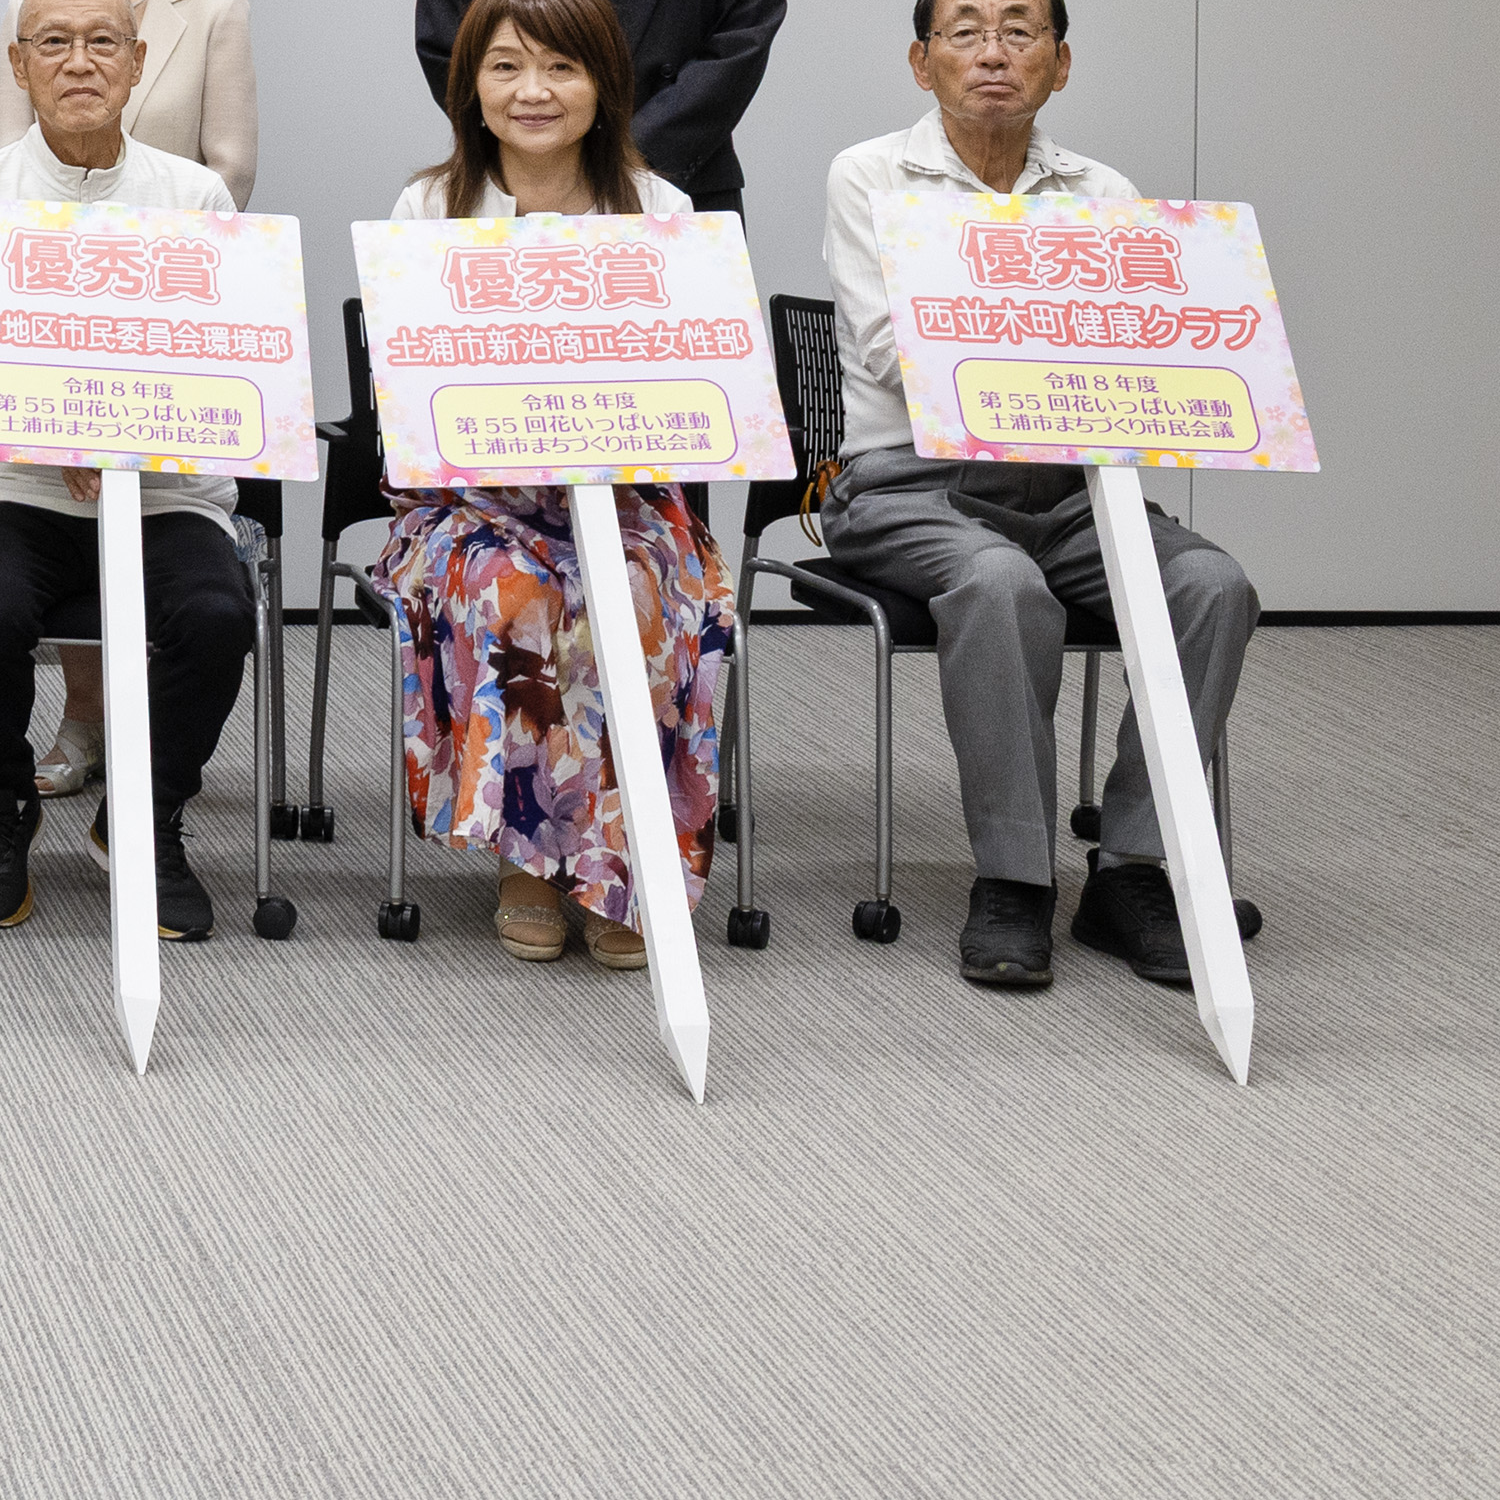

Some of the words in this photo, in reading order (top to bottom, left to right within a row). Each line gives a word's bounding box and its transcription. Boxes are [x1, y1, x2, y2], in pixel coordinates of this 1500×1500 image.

[2, 227, 221, 305] 優秀賞
[440, 243, 671, 314] 優秀賞
[958, 220, 1188, 295] 優秀賞
[387, 319, 752, 366] 土浦市新治商工会女性部
[912, 297, 1261, 351] 西並木町健康クラブ
[0, 416, 241, 447] 土浦市まちづくり市民会議
[464, 433, 713, 456] 土浦市まちづくり市民会議
[988, 413, 1236, 439] 土浦市まちづくり市民会議
